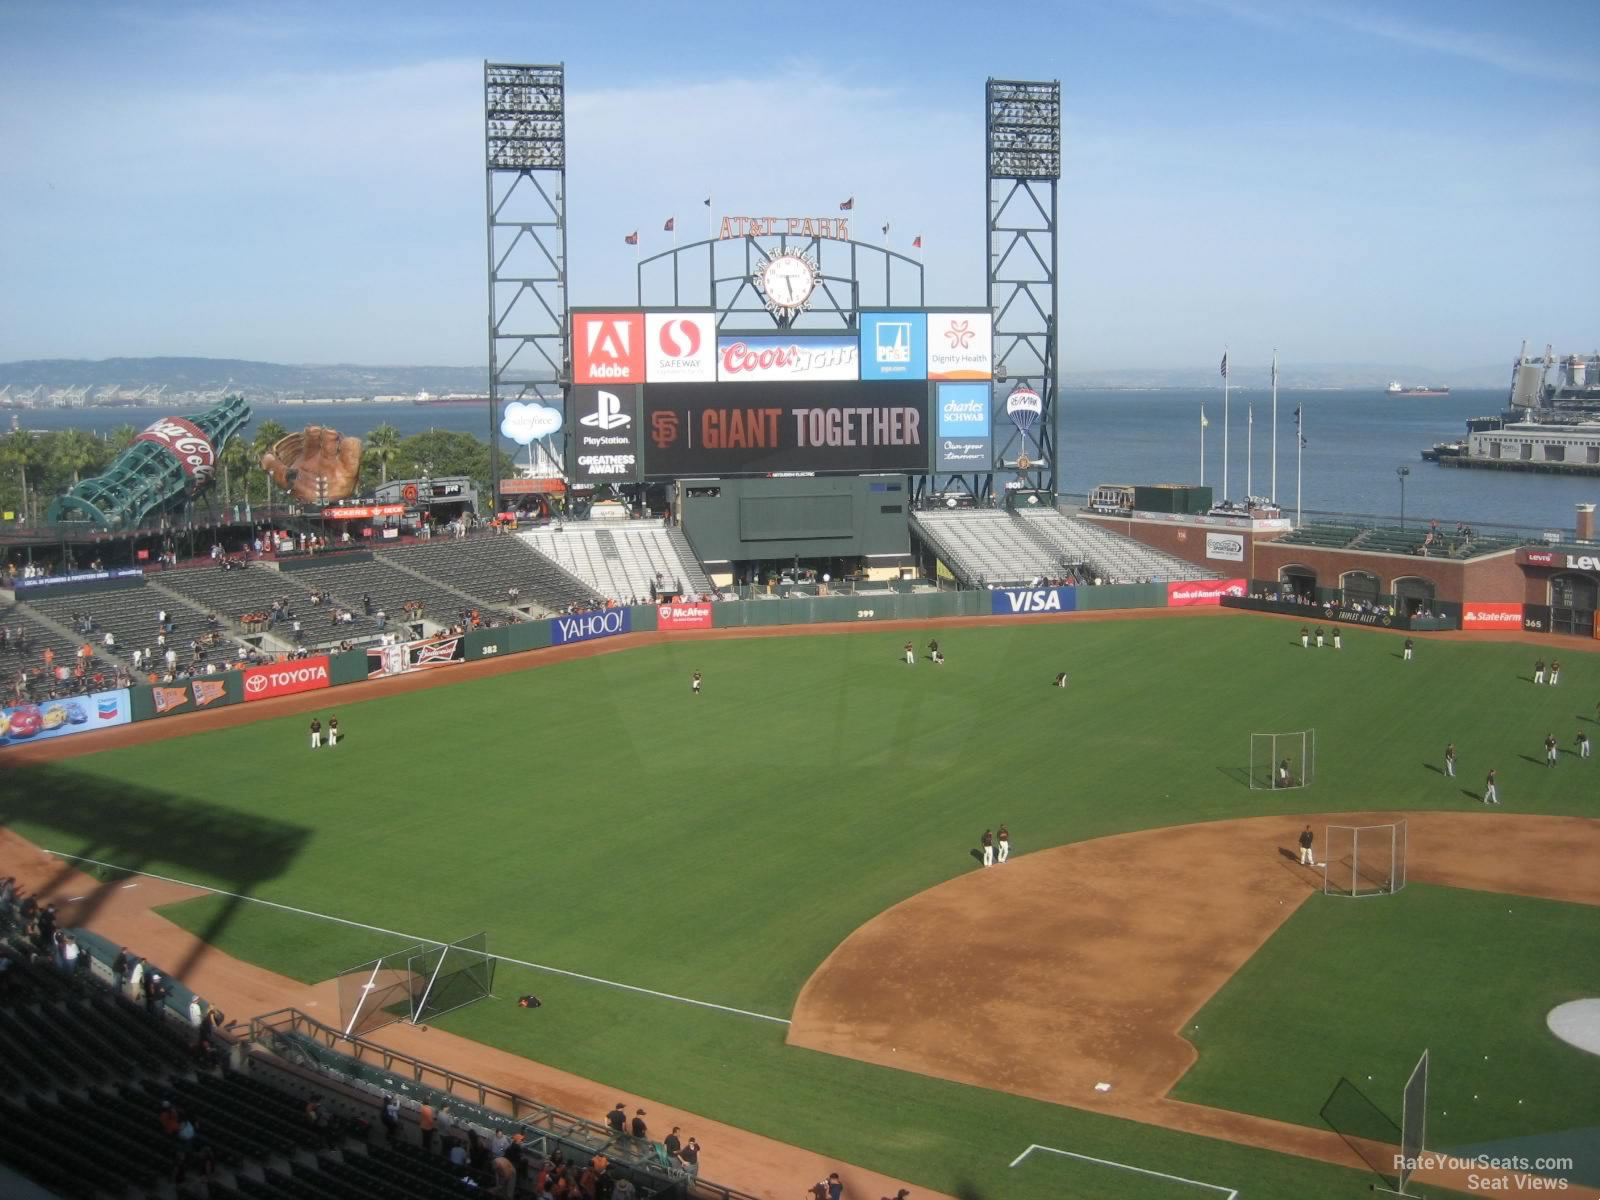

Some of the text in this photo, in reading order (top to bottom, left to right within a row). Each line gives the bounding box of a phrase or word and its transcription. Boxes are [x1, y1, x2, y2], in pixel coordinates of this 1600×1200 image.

[719, 216, 849, 240] AT&T PARK
[752, 258, 769, 286] SAN
[765, 300, 813, 318] GIANTS
[720, 342, 797, 373] Coors
[932, 354, 988, 364] Dignity Health
[659, 360, 701, 368] SAFEWAY
[589, 363, 630, 377] Adobe
[943, 400, 984, 412] charles
[943, 413, 984, 422] SCHWAB
[702, 408, 783, 449] GIANT
[792, 407, 920, 447] TOGETHER
[584, 436, 630, 447] PlayStation
[578, 455, 635, 466] GREATNESS
[588, 464, 628, 474] AWAITS
[1173, 591, 1192, 599] Bank
[1006, 591, 1061, 611] VISA
[672, 607, 710, 617] McAfee
[857, 610, 874, 618] 399
[559, 610, 624, 641] YAHOO!
[1525, 619, 1542, 628] 365
[482, 645, 498, 655] 382
[269, 666, 328, 687] TOYOTA
